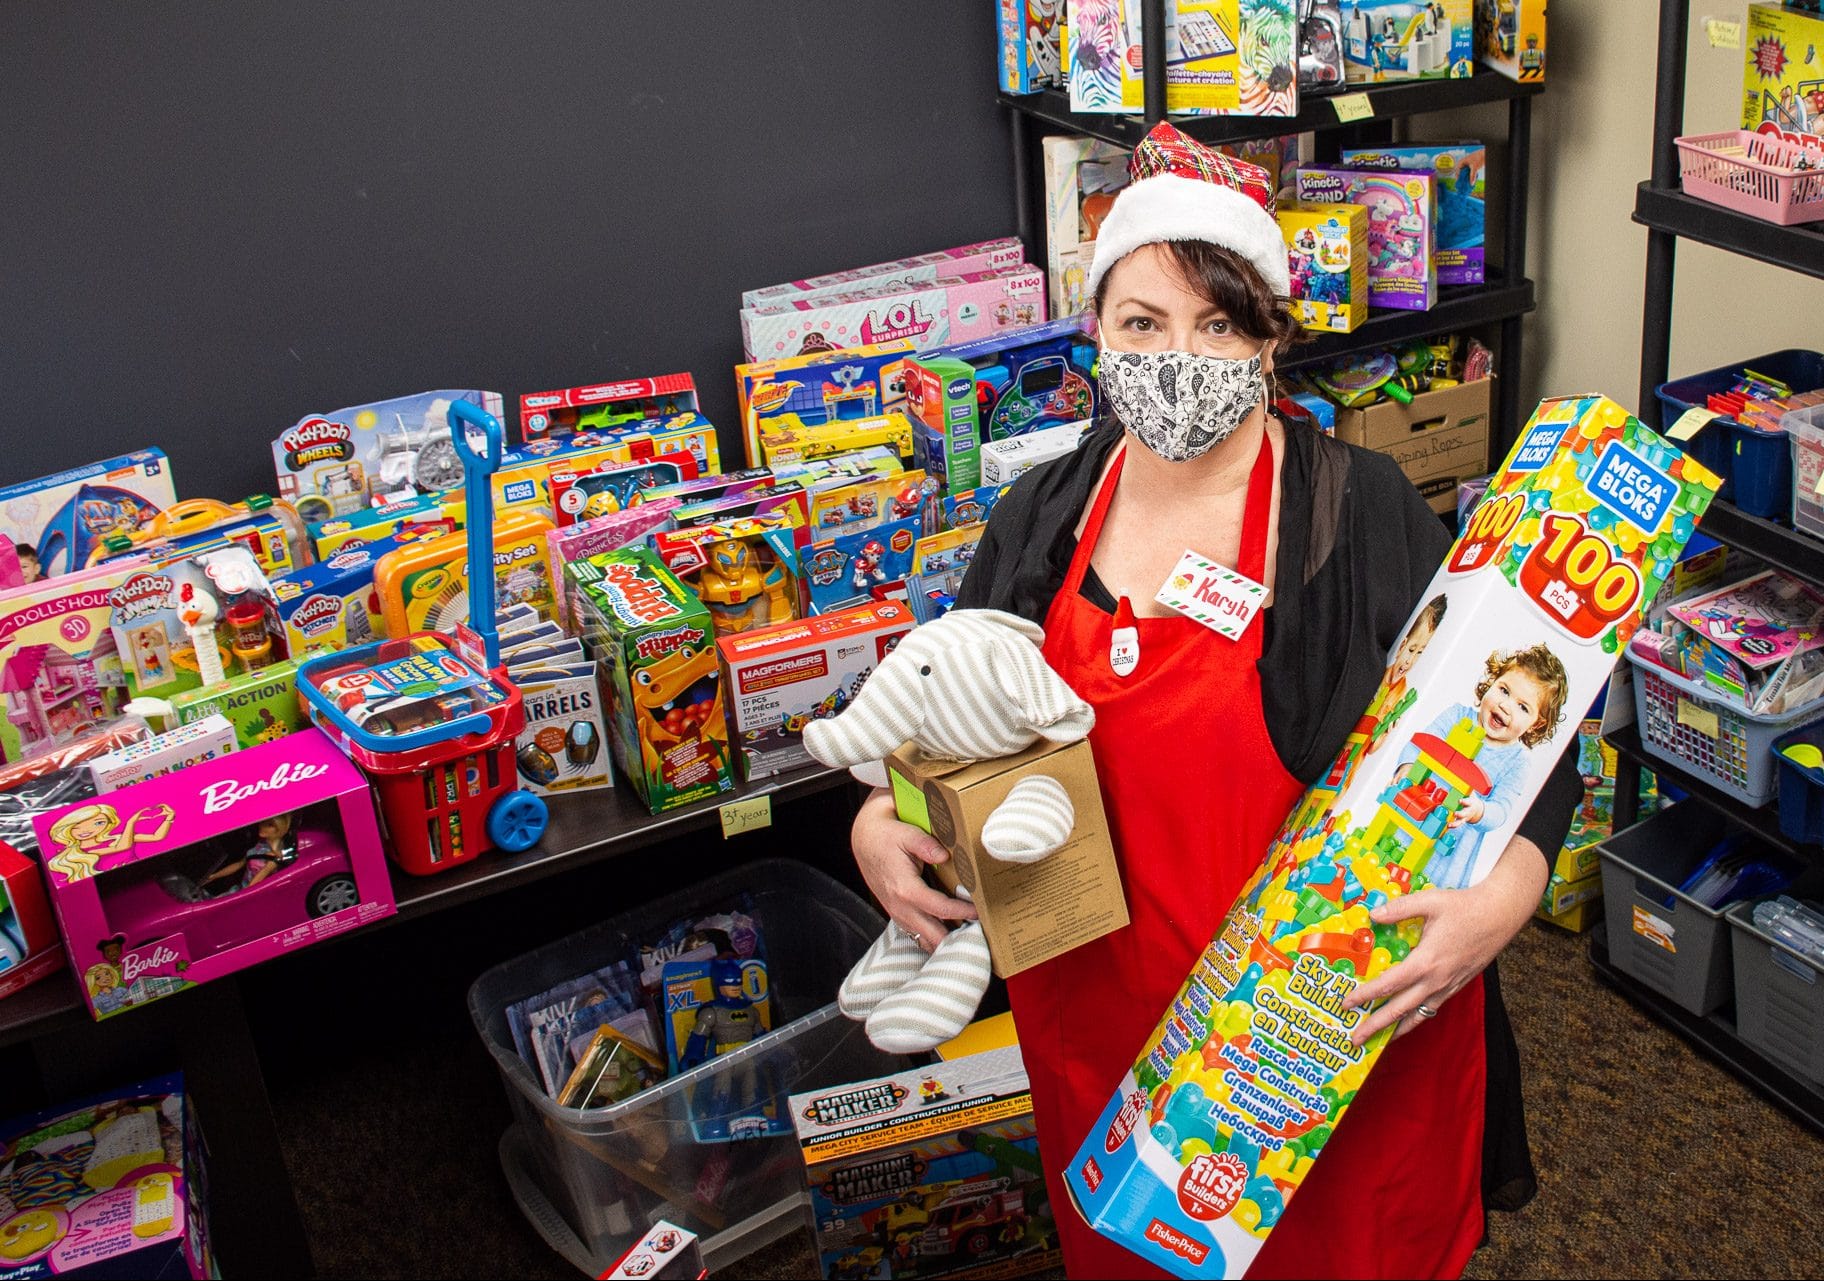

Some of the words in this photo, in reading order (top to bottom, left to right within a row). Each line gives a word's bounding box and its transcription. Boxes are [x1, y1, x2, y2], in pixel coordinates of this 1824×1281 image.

[1006, 251, 1020, 260] 100
[872, 324, 923, 343] SURPRISE!
[948, 382, 971, 394] vtech
[1528, 430, 1558, 446] MEGA
[297, 444, 343, 465] WHEELS
[771, 452, 801, 463] HONEY
[1518, 447, 1548, 463] BLOKS
[507, 484, 531, 494] MEGA
[1608, 454, 1665, 498] MEGA
[507, 489, 533, 500] BLOKS
[568, 494, 577, 505] 5
[1597, 472, 1658, 521] BLOKS
[1466, 494, 1526, 542] 100
[513, 544, 537, 562] Set
[576, 532, 625, 560] PRINCESS
[1543, 516, 1637, 612] 100
[67, 587, 112, 607] HOUS
[112, 576, 172, 606] Play-Doh
[1549, 589, 1570, 610] PCS
[294, 599, 340, 625] Play-Doh
[63, 619, 87, 639] 3D
[742, 654, 823, 679] MAGFORMERS
[1112, 655, 1134, 666] CHRISTMAS
[226, 682, 288, 711] ACTION
[524, 691, 592, 722] RRELS
[525, 695, 544, 705] ears
[752, 696, 767, 705] PCS
[171, 750, 216, 773] BLOCKS
[201, 762, 329, 815] Barbie
[740, 807, 769, 826] years
[122, 945, 179, 981] Barbie
[1297, 955, 1334, 987] Sky
[1330, 974, 1373, 1012] Hi
[668, 990, 700, 1012] XL
[1256, 988, 1364, 1062] Construction
[1253, 1012, 1279, 1034] en
[1278, 1021, 1347, 1072] hauteur
[1251, 1037, 1324, 1087] Rascacielos
[1220, 1044, 1259, 1074] Mega
[1258, 1067, 1330, 1116] Construção
[817, 1085, 892, 1110] MACHINE
[820, 1096, 896, 1123] MAKER
[1223, 1070, 1308, 1124] Grenzenloser
[810, 1131, 843, 1145] JUNIOR
[844, 1123, 884, 1138] BUILDER
[889, 1103, 960, 1125] CONSTRUCTEUR
[961, 1096, 994, 1109] JUNIOR
[1230, 1092, 1287, 1130] Bauspaß
[811, 1141, 838, 1154] MEGA
[838, 1137, 859, 1149] CITY
[859, 1130, 898, 1144] SERVICE
[899, 1121, 925, 1135] TEAM
[930, 1111, 963, 1125] ÉQUIPE
[964, 1109, 977, 1118] DE
[978, 1099, 1014, 1114] SERVICE
[1210, 1104, 1285, 1152] Небоскреб
[835, 1155, 913, 1183] MACHINE
[838, 1168, 916, 1199] MAKER
[1184, 1179, 1229, 1211] Builders
[1190, 1201, 1204, 1216] 1+
[823, 1219, 846, 1233] 39
[73, 1238, 120, 1254] transforme
[1151, 1223, 1203, 1259] Fisher-Price
